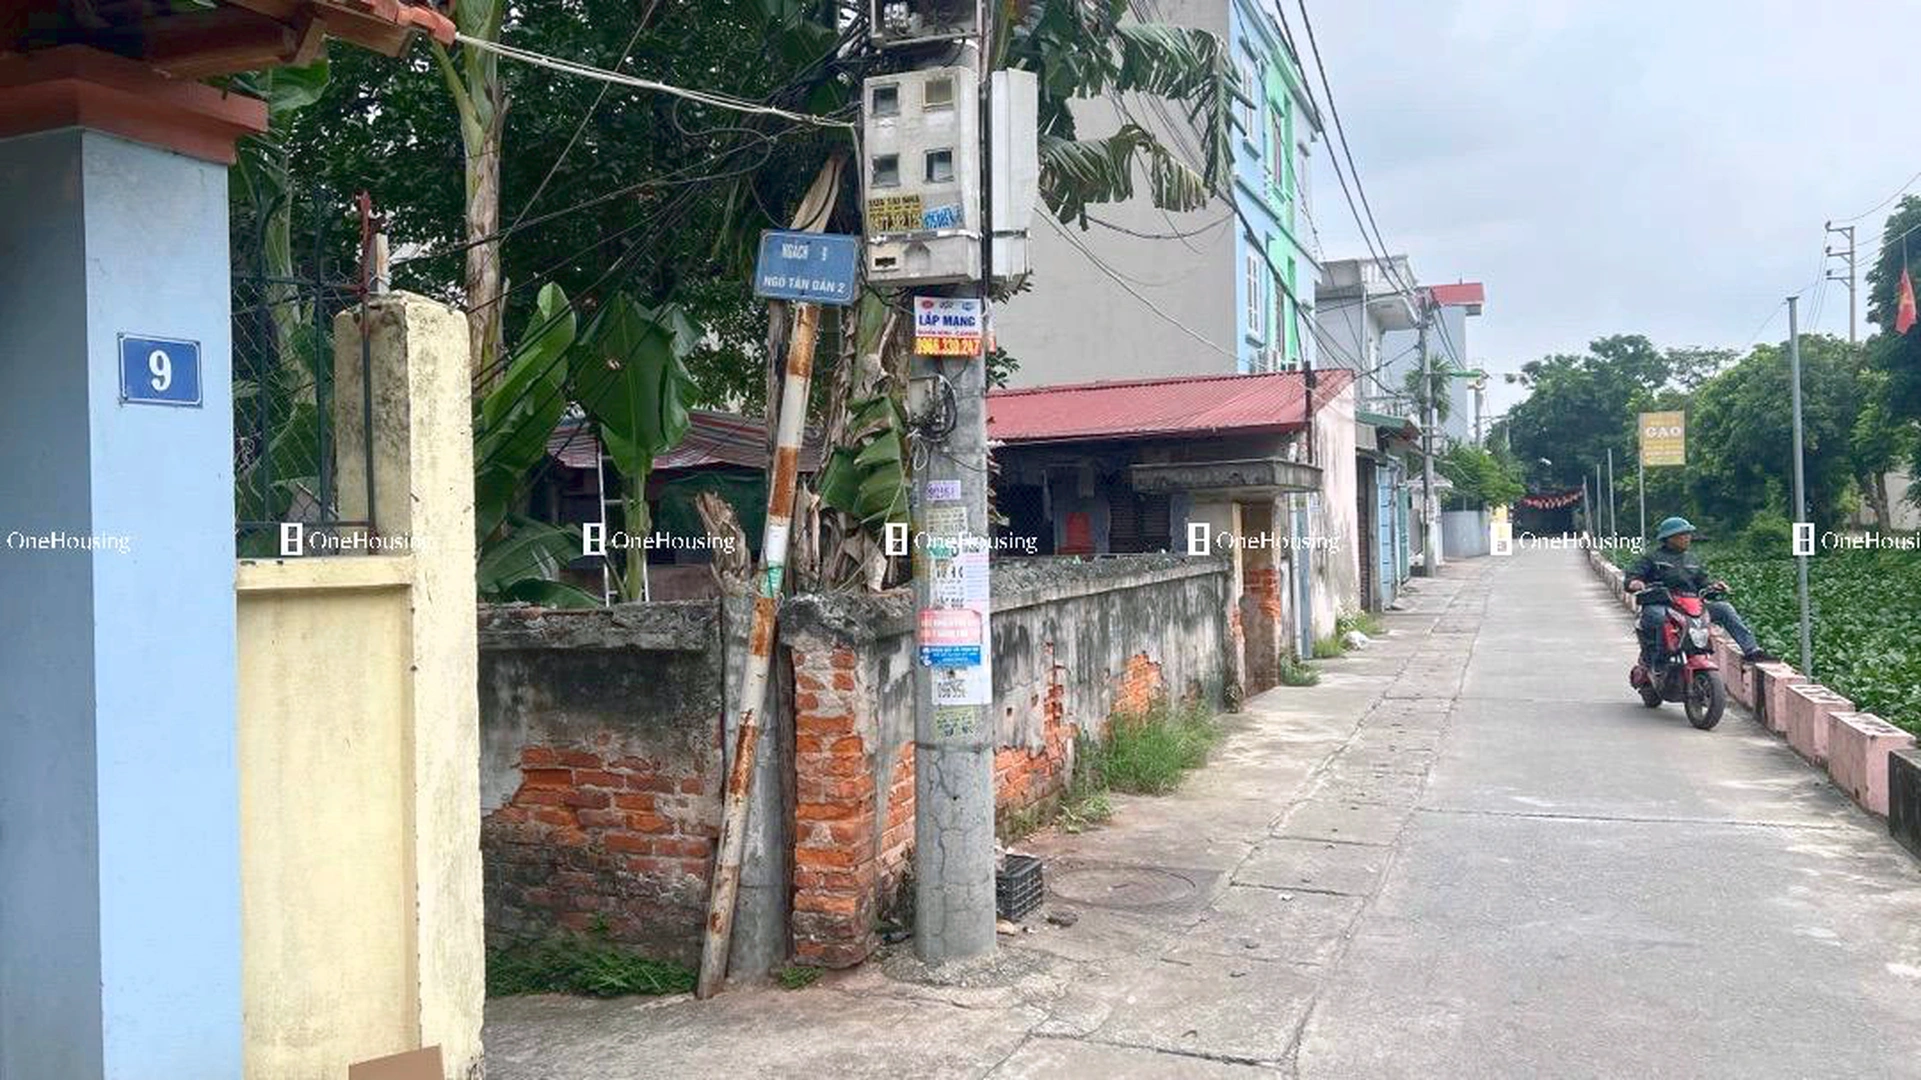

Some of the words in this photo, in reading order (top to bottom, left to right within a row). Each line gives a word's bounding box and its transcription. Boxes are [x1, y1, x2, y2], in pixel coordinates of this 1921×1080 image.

[836, 282, 846, 294] 2
[943, 315, 976, 329] MẠNG
[148, 349, 172, 391] 9
